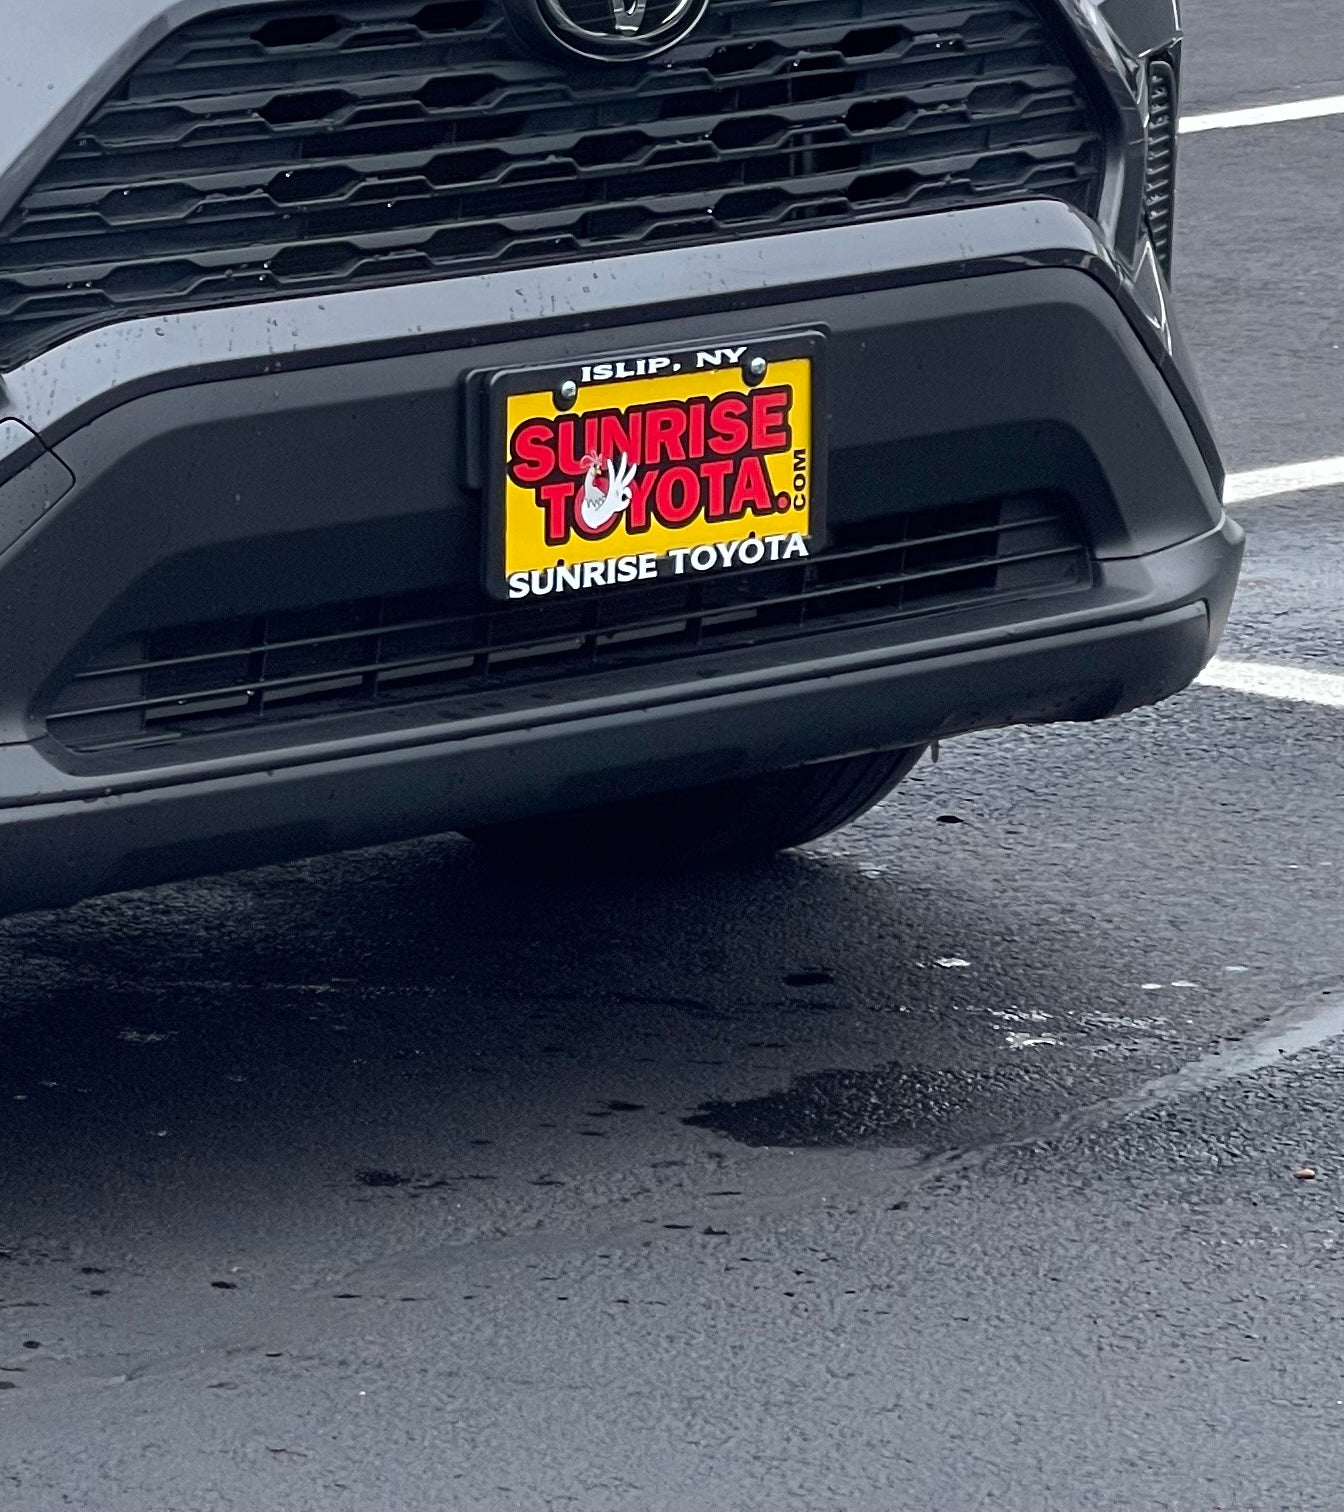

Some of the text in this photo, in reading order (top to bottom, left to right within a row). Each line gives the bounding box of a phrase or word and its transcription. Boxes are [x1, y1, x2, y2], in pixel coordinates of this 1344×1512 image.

[696, 346, 748, 369] NY
[512, 390, 790, 483] SUNRISE
[508, 532, 810, 600] SUNRISE TOYOTA
